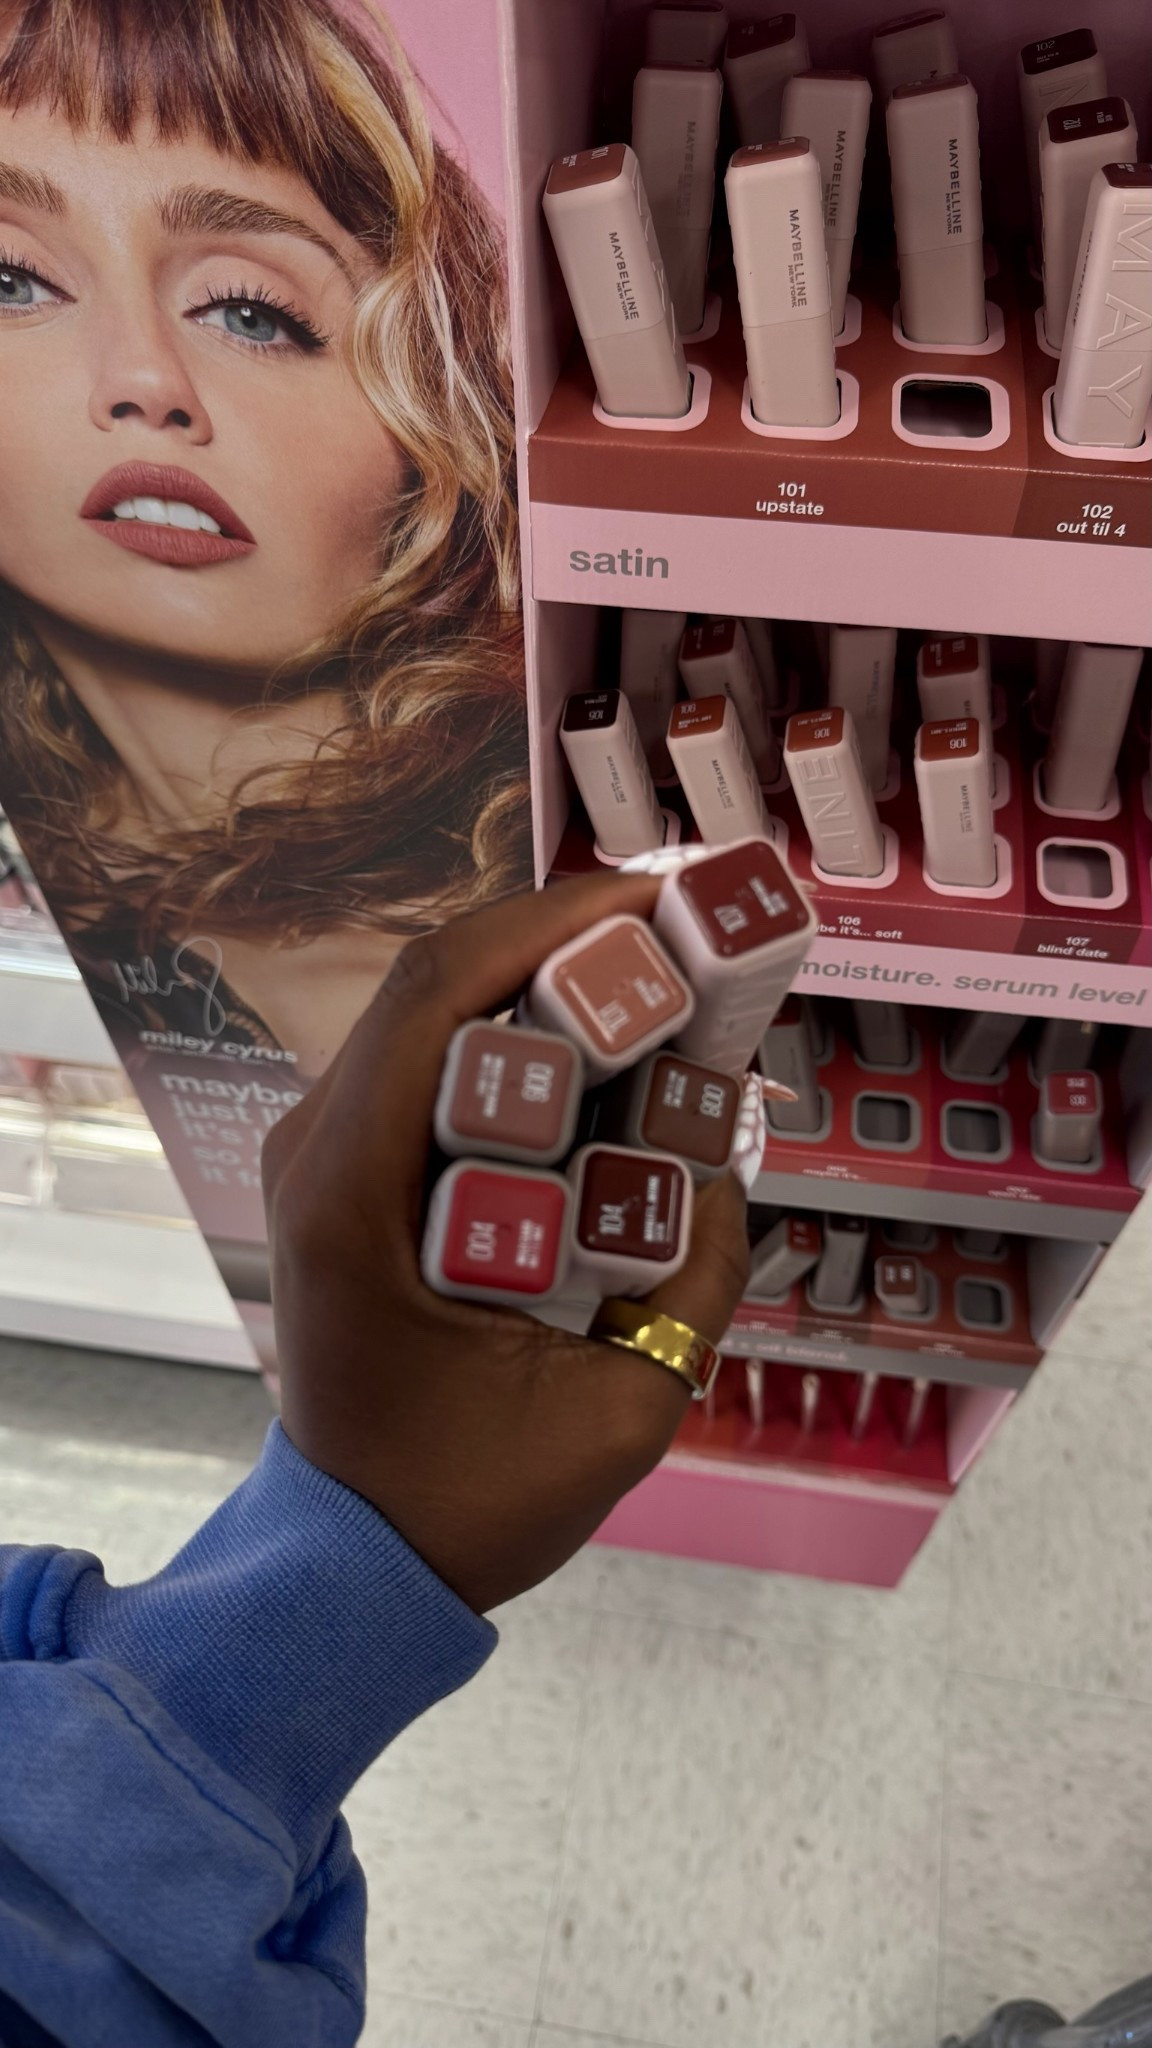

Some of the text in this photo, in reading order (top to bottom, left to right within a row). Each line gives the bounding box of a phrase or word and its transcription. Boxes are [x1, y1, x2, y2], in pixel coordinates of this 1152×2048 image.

[1036, 39, 1056, 51] 102
[825, 130, 846, 227] MAYBELLINE
[948, 138, 962, 234] MAYBELLINE
[788, 208, 808, 307] MAYBELLINE
[608, 231, 640, 320] MAYBELLINE
[787, 264, 798, 308] NEW YORK
[615, 282, 631, 321] NEW YORK
[777, 482, 807, 498] 101
[755, 500, 825, 516] upstate
[1081, 503, 1114, 519] 102
[1056, 521, 1127, 538] out til 4
[569, 547, 670, 579] satin
[813, 727, 831, 739] 106
[949, 737, 967, 749] 106
[711, 759, 735, 809] MAYBELLINE
[960, 784, 973, 833] MAYBELLINE
[837, 915, 861, 926] 106
[875, 930, 903, 939] soft
[1036, 943, 1109, 959] blind date
[1065, 936, 1092, 947] 107
[953, 974, 1059, 998] serum
[1068, 982, 1149, 1007] level
[139, 1029, 215, 1052] miley
[220, 1040, 298, 1065] cyrus
[160, 1072, 305, 1107] maybe
[699, 1082, 725, 1119] 008
[170, 1093, 253, 1125] just
[180, 1118, 244, 1146] it's
[192, 1145, 241, 1166] so
[598, 1203, 626, 1237] 104
